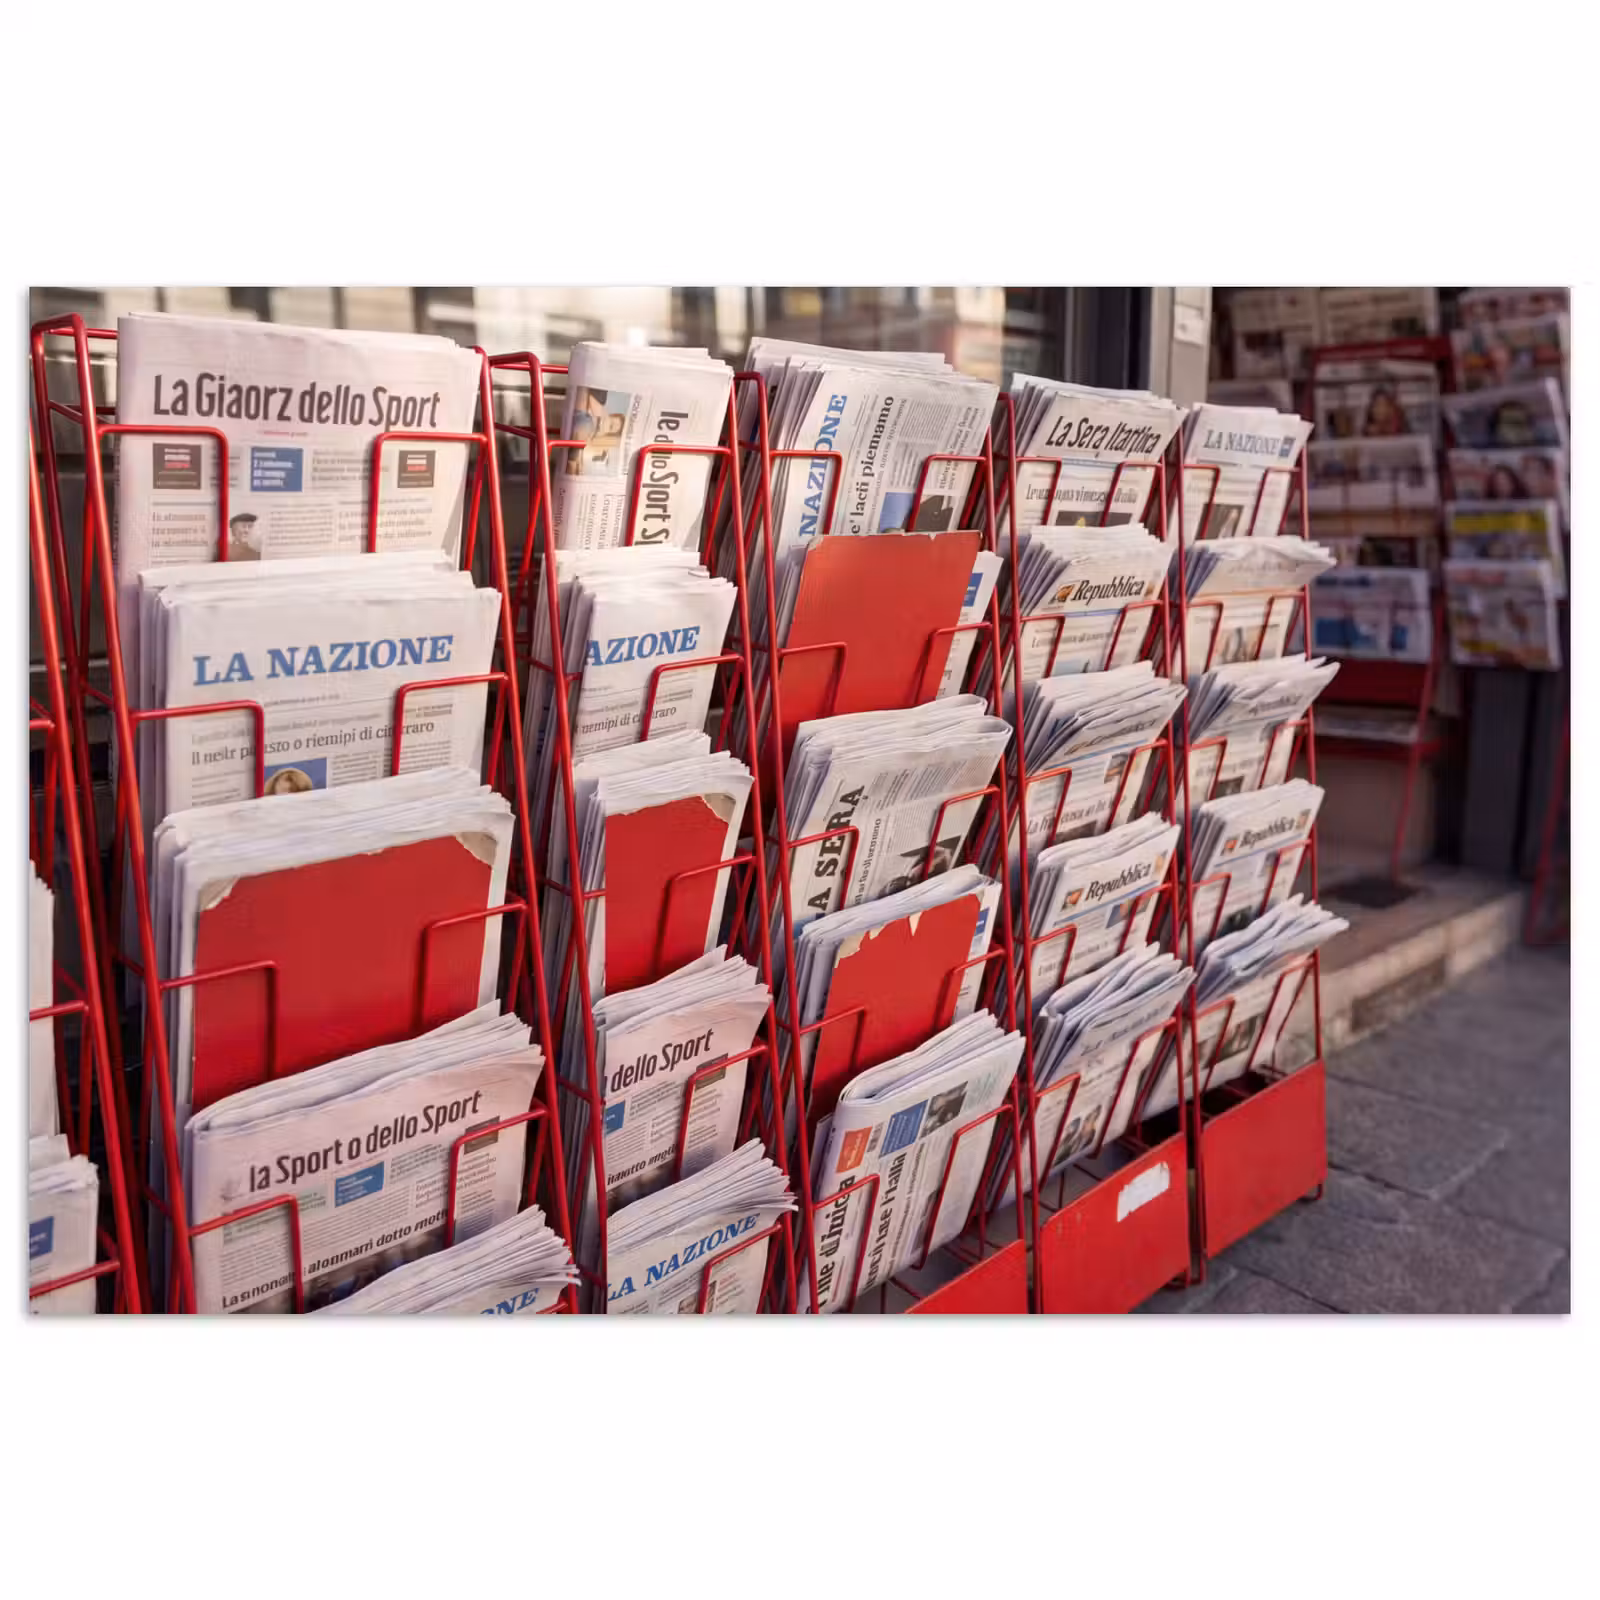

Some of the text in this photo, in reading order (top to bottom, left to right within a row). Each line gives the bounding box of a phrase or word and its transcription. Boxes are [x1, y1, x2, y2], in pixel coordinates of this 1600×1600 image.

[153, 372, 440, 433] La Giaorz dello Sport
[1045, 416, 1073, 447] La
[1071, 575, 1145, 606] Repubblica
[192, 634, 454, 686] LA NAZIONE
[360, 725, 373, 742] di
[611, 1028, 714, 1093] dello Sport
[275, 1139, 342, 1185] Sport
[348, 1137, 361, 1160] o
[366, 1113, 418, 1154] dello
[421, 1089, 482, 1135] Sport
[644, 1213, 761, 1287] NAZIONE
